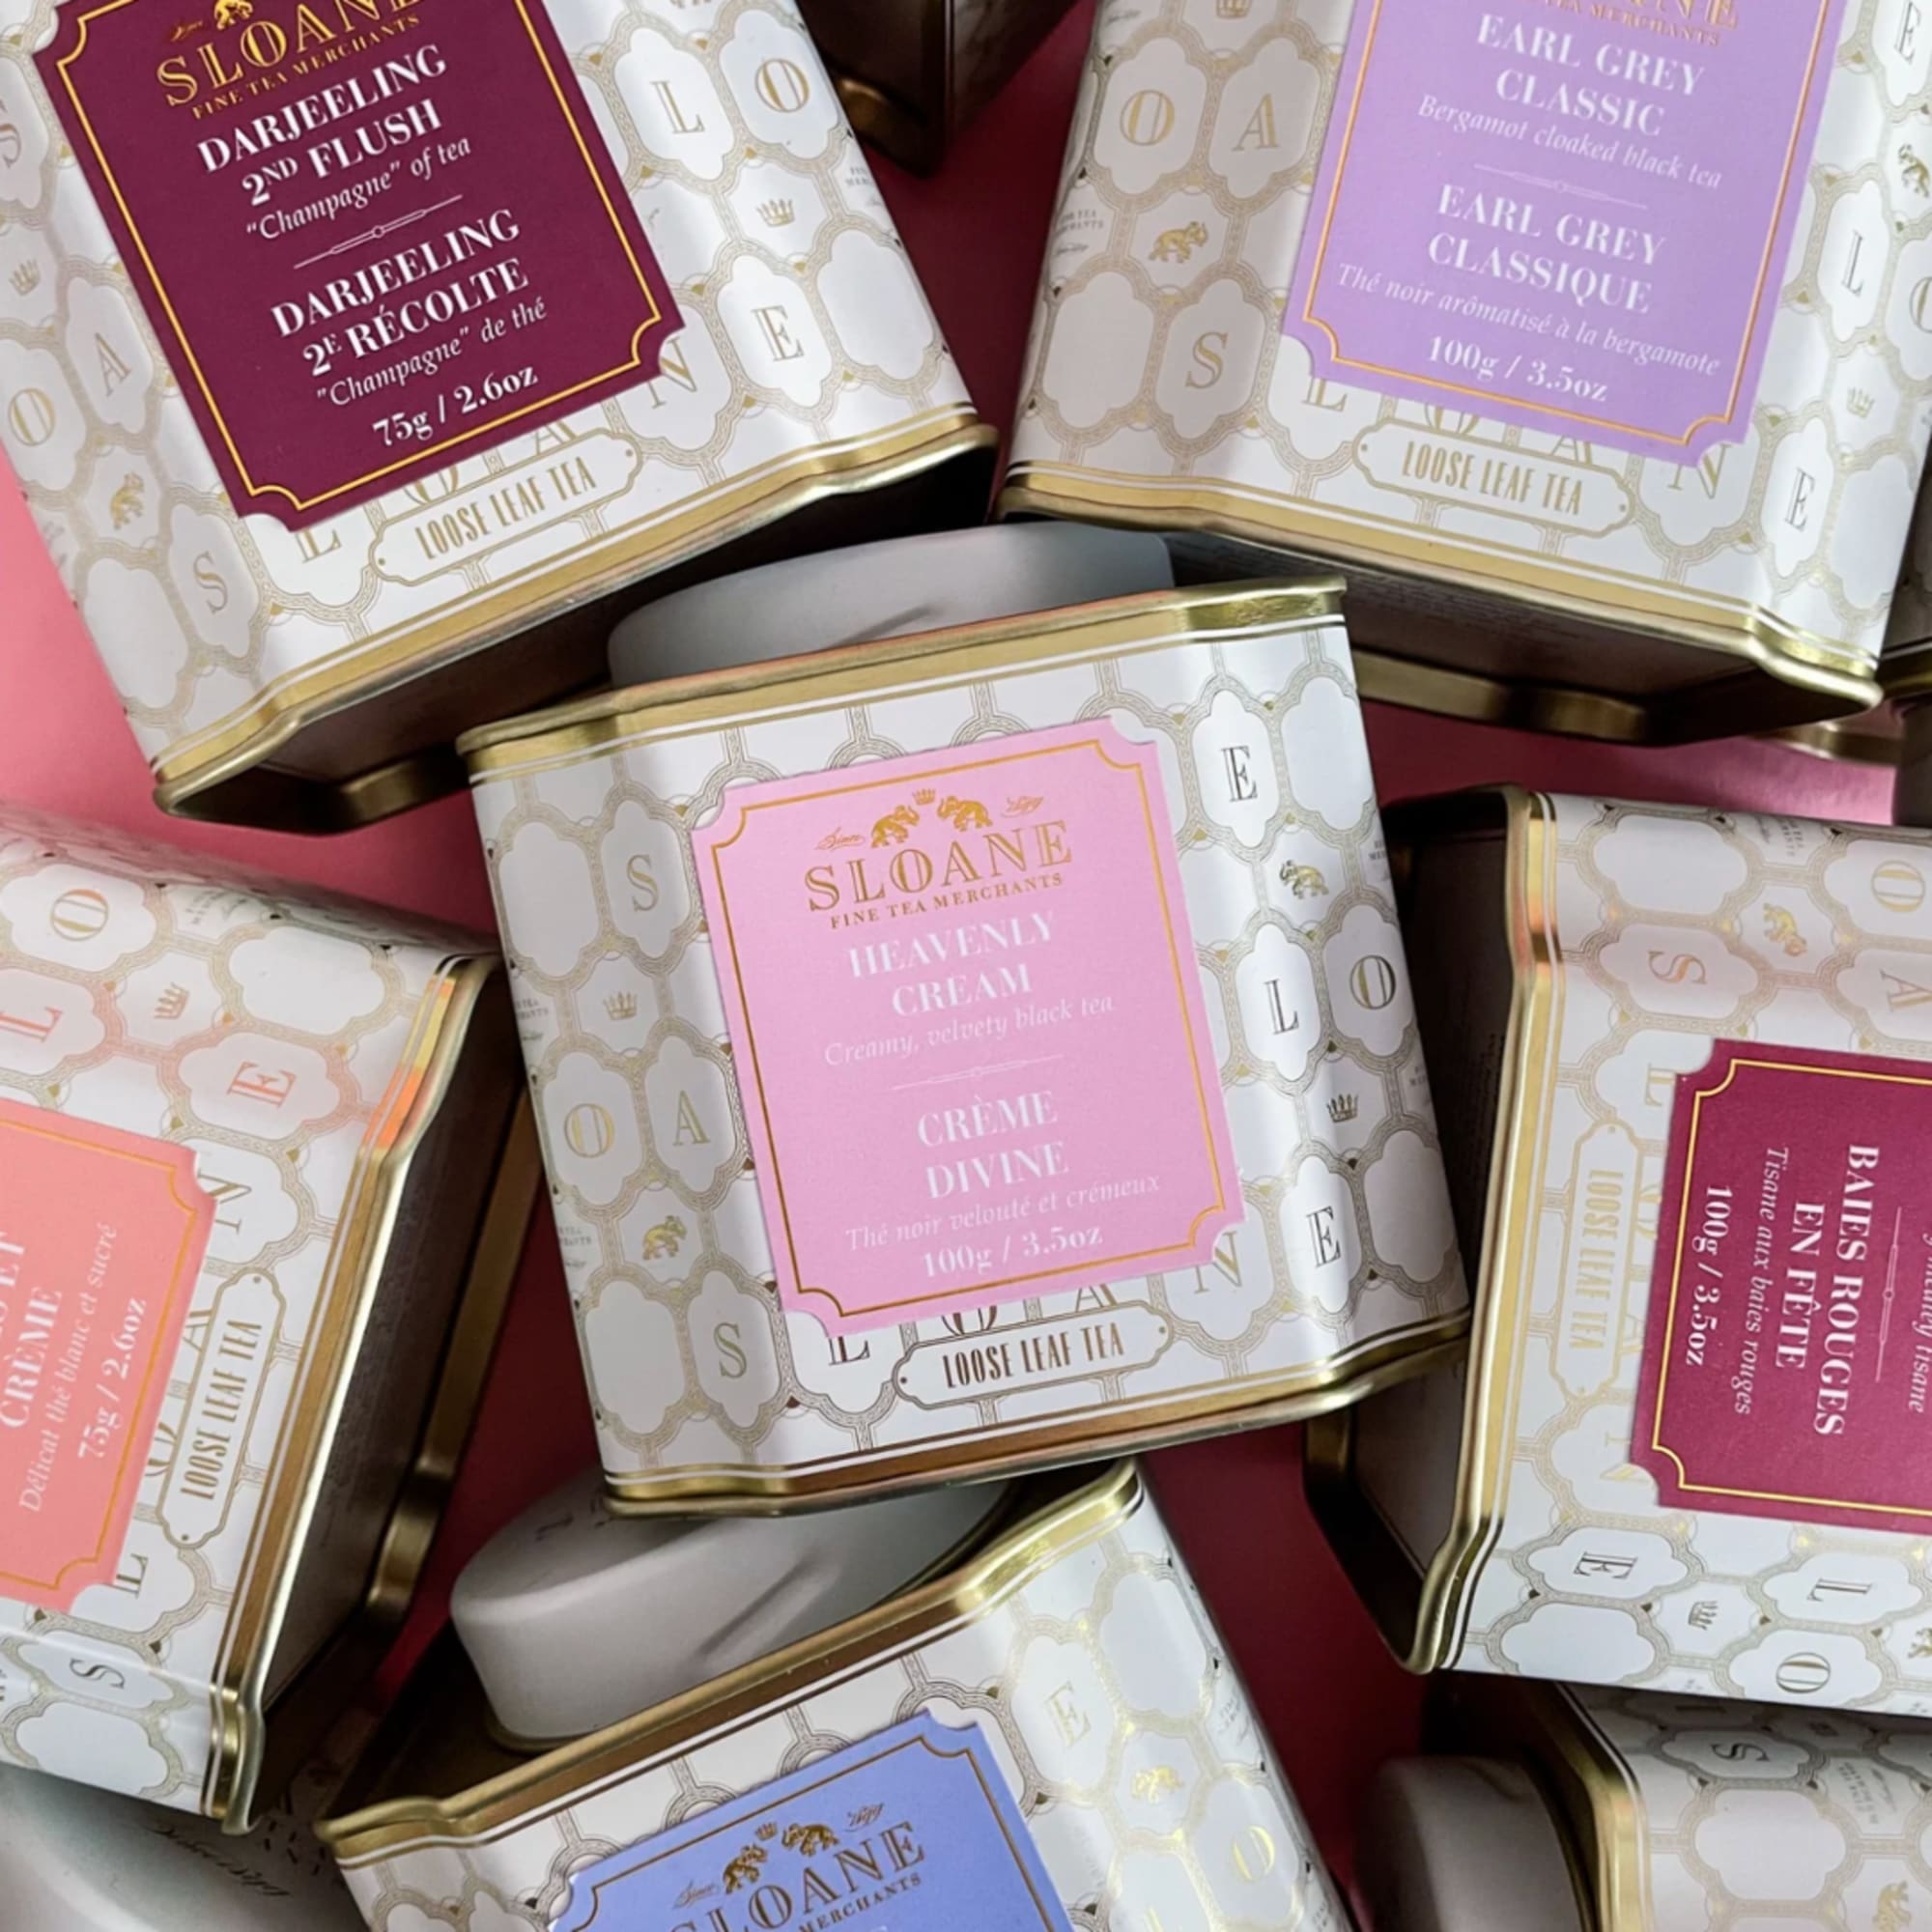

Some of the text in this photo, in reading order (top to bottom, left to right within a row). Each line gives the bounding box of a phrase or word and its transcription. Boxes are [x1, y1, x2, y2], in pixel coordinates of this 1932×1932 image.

[1476, 14, 1581, 69] EARL
[1596, 43, 1705, 96] GREY
[1590, 4, 1721, 47] MERCHANTS
[192, 14, 420, 120] FINE TEA MERCHANTS
[197, 44, 446, 172] DARJEELING
[1120, 89, 1176, 147] O
[1231, 94, 1280, 152] A
[1496, 69, 1664, 137] CLASSIC
[242, 99, 442, 206] 2ND FLUSH
[411, 148, 432, 181] of
[438, 137, 471, 165] tea
[1418, 95, 1724, 188] Bergamot cloaked black tea
[1438, 184, 1666, 267] EARL GREY
[270, 209, 521, 337] DARJEELING
[1429, 232, 1653, 315] CLASSIQUE
[302, 258, 529, 377] 2E RÉCOLTE
[480, 317, 507, 343] de
[513, 296, 548, 329] thé
[751, 304, 805, 362] E
[1338, 263, 1721, 377] Thé noir arômatisé à la bergamote
[1185, 330, 1229, 389] S
[1429, 335, 1609, 403] 100g / 3.5oz
[373, 365, 539, 447] 75g / 2.6oz
[413, 504, 490, 560] LOOSE
[489, 474, 547, 527] LEAF
[548, 455, 597, 502] TEA
[1401, 440, 1584, 516] LOOSE LEAF TEA
[1220, 745, 1260, 804] E
[625, 853, 660, 914] S
[804, 820, 1072, 912] SLOANE
[831, 872, 1063, 930] FINE TEA MERCHANTS
[847, 910, 1055, 979] HEAVENLY
[892, 963, 1033, 1016] CREAM
[1263, 978, 1300, 1036] L
[1349, 953, 1397, 1011] O
[824, 994, 1115, 1066] Creamy, velvety black tea
[562, 1102, 615, 1159] O
[672, 1089, 711, 1148] A
[917, 1090, 1059, 1148] CRÈME
[925, 1140, 1070, 1200] DIVINE
[844, 1223, 889, 1252] Thé
[896, 1214, 943, 1241] noir
[951, 1196, 1031, 1232] velouté
[1038, 1192, 1059, 1212] et
[923, 1225, 1103, 1278] 100g / 3.5oz
[1305, 1205, 1344, 1269] E
[1569, 1170, 1624, 1350] LOOSE LEAF TEA
[1686, 1184, 1733, 1366] 100g / 3.5oz
[1730, 1147, 1789, 1415] Tisane aux baies rouges
[1775, 1202, 1826, 1370] EN FÊTE
[1813, 1144, 1880, 1435] BAIES ROUGES
[0, 1286, 63, 1428] CRÈME
[18, 1222, 118, 1512] Délicat thé blanc et sucré
[77, 1406, 124, 1460] 75g
[101, 1297, 147, 1380] 2.6oz
[712, 1321, 749, 1380] S
[941, 1321, 1126, 1389] LOOSE LEAF TEA
[180, 1320, 263, 1501] LOOSE LEAF TEA
[798, 1872, 922, 1932] MERCHANTS
